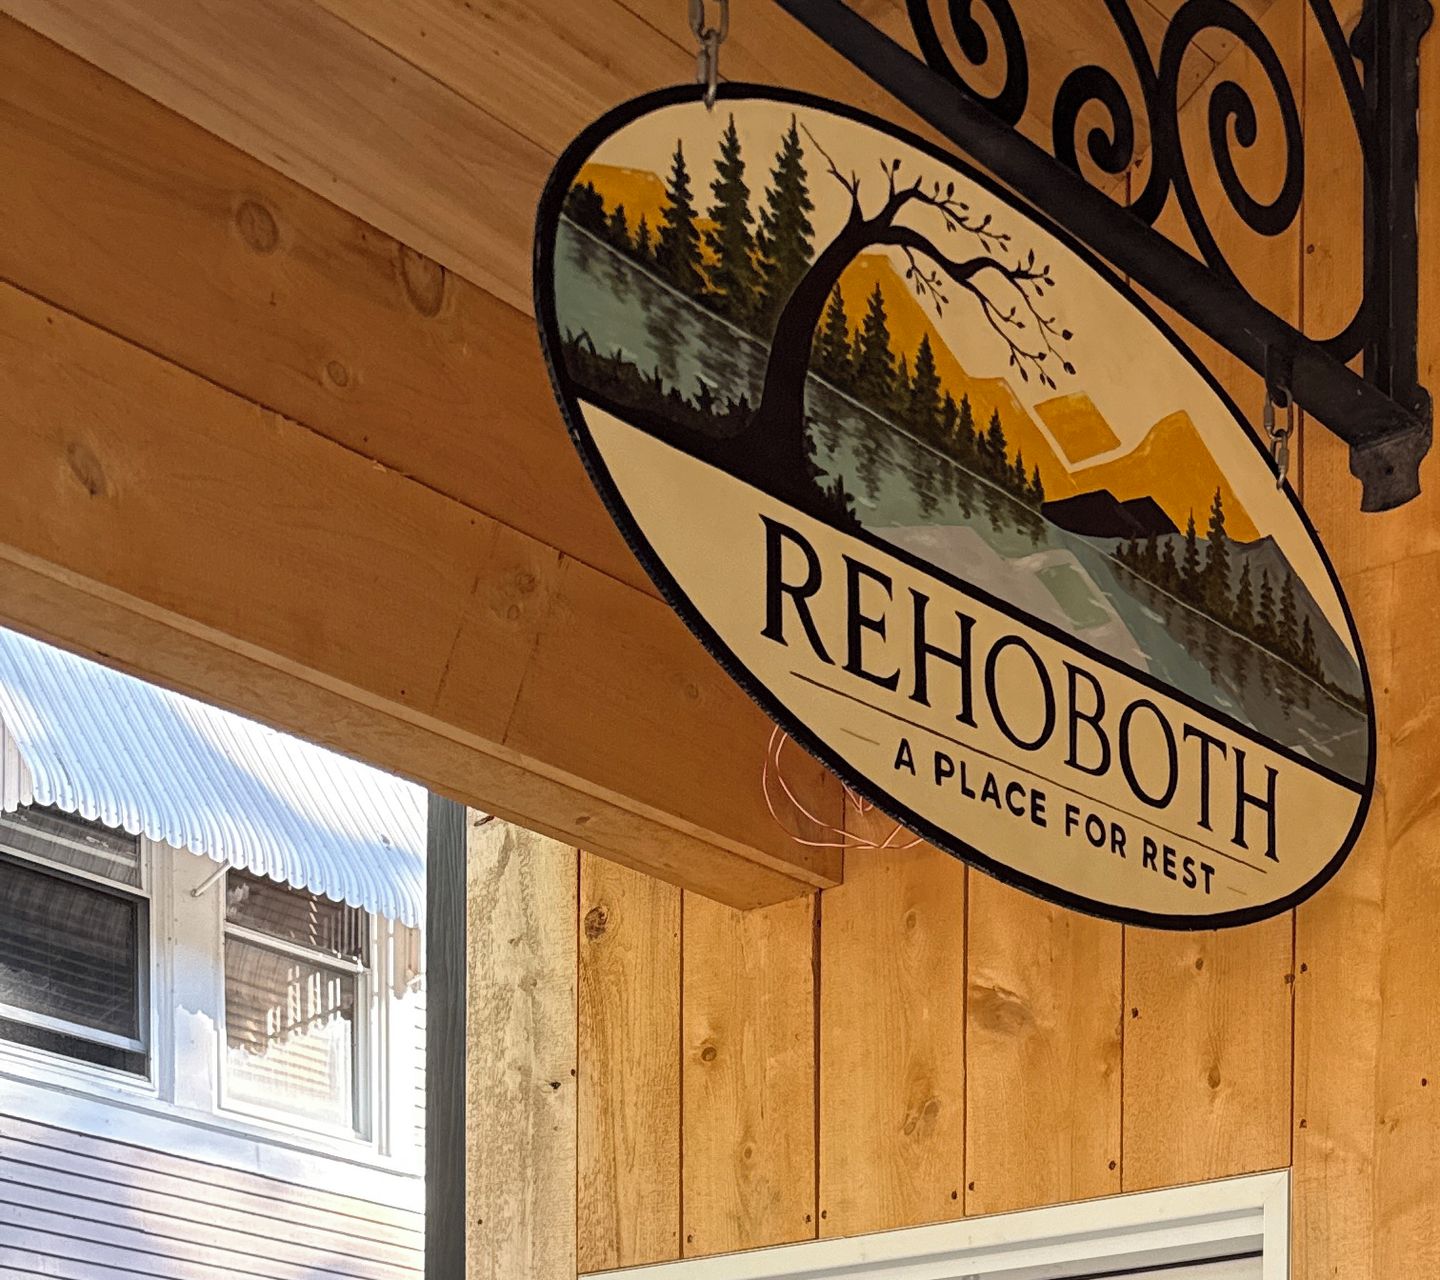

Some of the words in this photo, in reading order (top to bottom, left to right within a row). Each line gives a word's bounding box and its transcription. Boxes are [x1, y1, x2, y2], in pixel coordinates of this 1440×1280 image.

[758, 513, 1280, 863] REHOBOTH
[894, 737, 917, 775] A
[934, 751, 1048, 828] PLACE
[1066, 803, 1126, 858] FOR
[1143, 836, 1216, 894] REST
